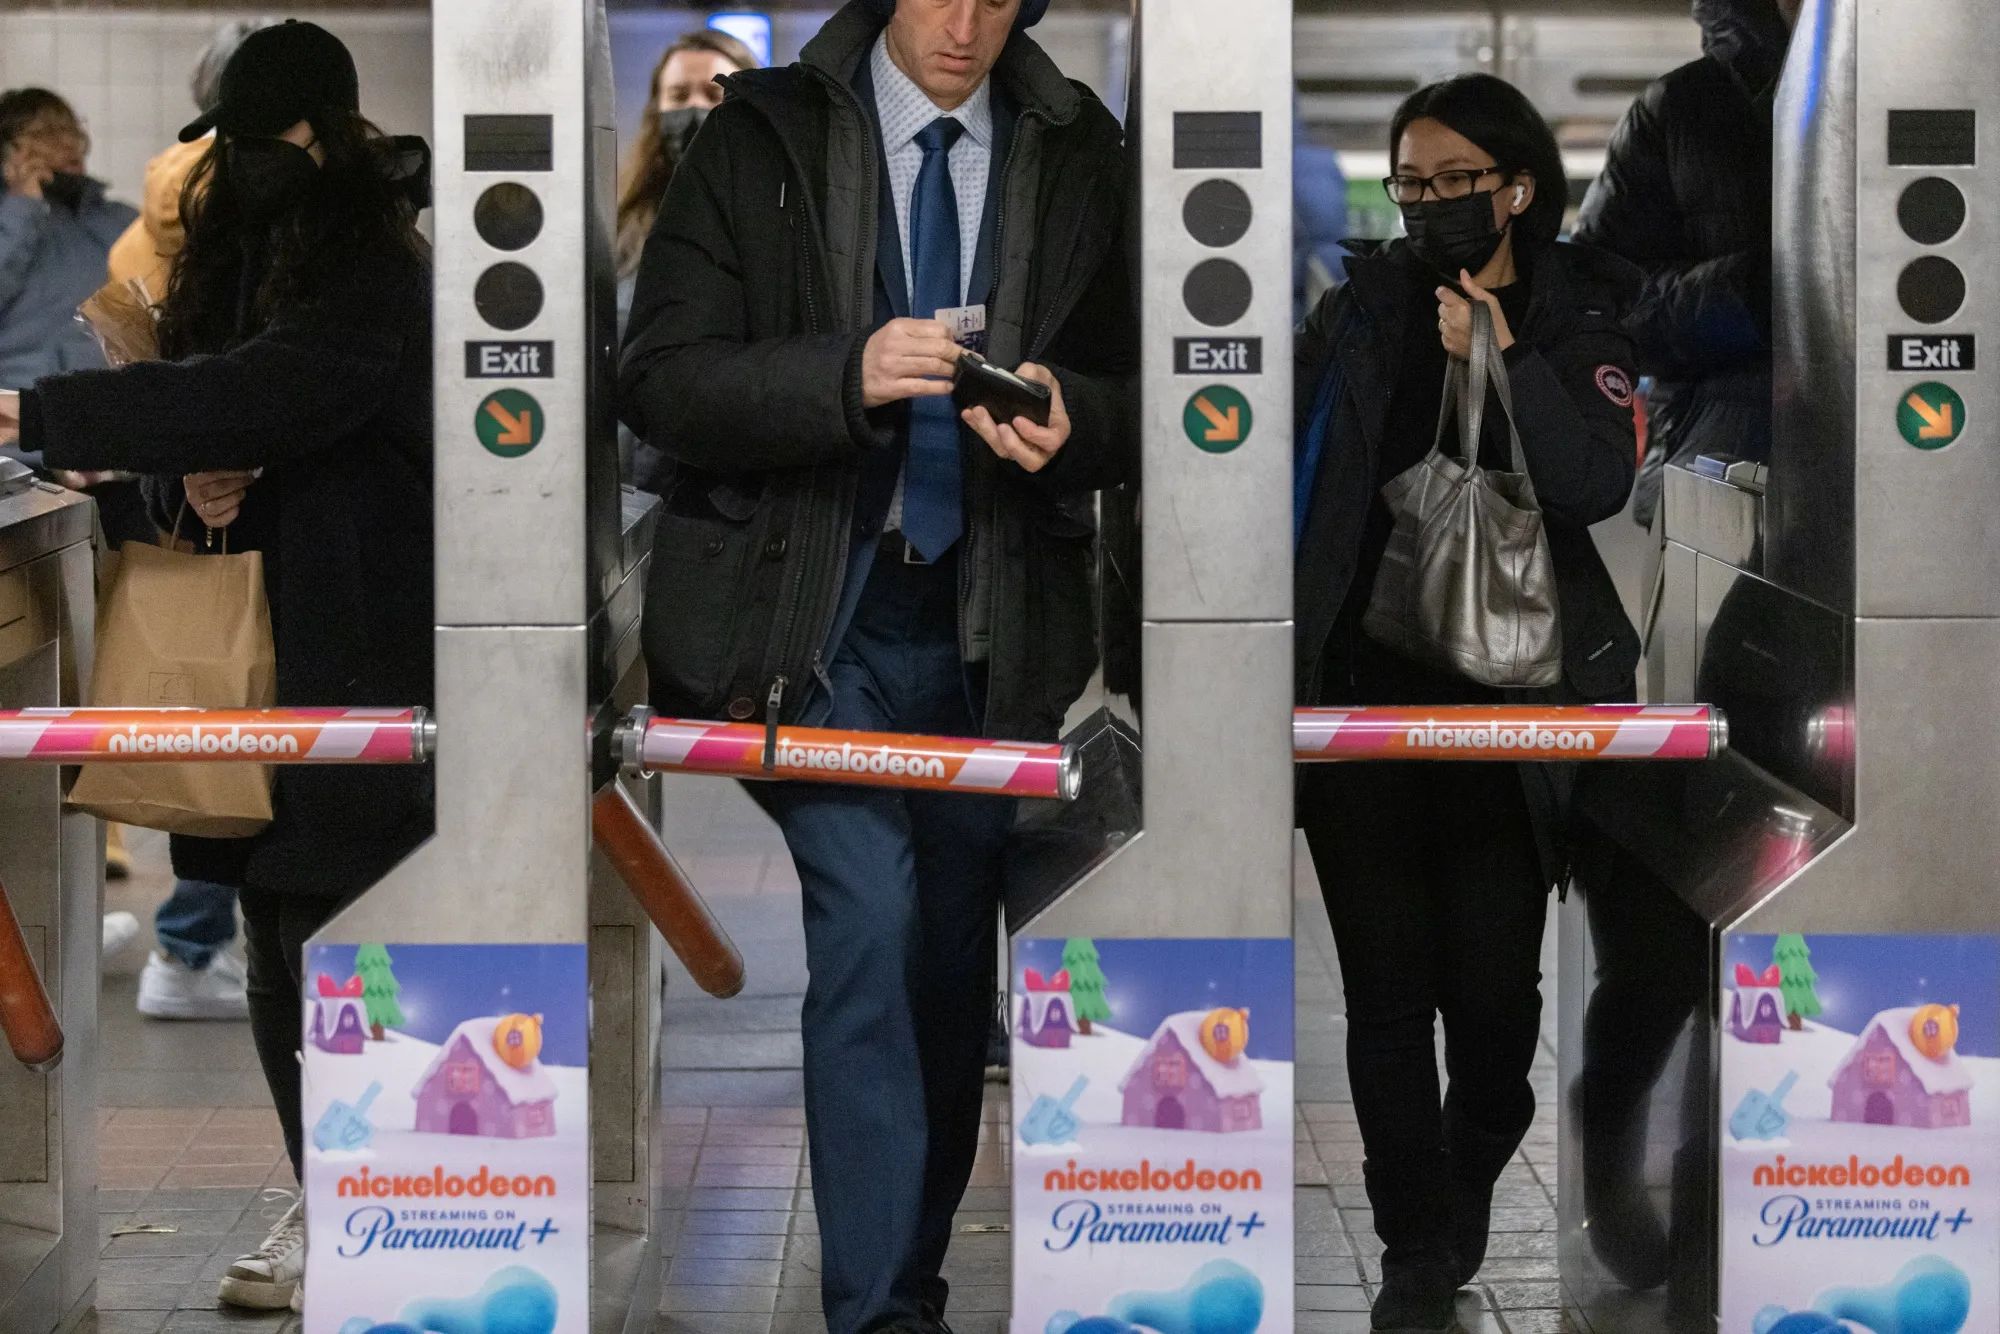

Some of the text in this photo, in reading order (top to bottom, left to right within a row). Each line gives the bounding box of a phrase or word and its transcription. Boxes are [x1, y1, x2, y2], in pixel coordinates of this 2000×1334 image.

[481, 345, 540, 374] Exit
[1189, 342, 1248, 370] Exit
[1902, 339, 1960, 368] Exit
[108, 723, 298, 754] nickelodeon
[1406, 718, 1595, 750] nickelodeon
[337, 1165, 556, 1197] nickelodeon
[1044, 1159, 1262, 1191] nickelodeon
[1753, 1154, 1970, 1187] nickelodeon
[401, 1209, 516, 1221] STREAMING ON
[1107, 1203, 1222, 1214] STREAMING ON
[1816, 1199, 1930, 1210] STREAMING ON
[337, 1205, 559, 1258] Paramount+
[1044, 1199, 1265, 1252] Paramount+
[1752, 1194, 1973, 1247] Paramount+
